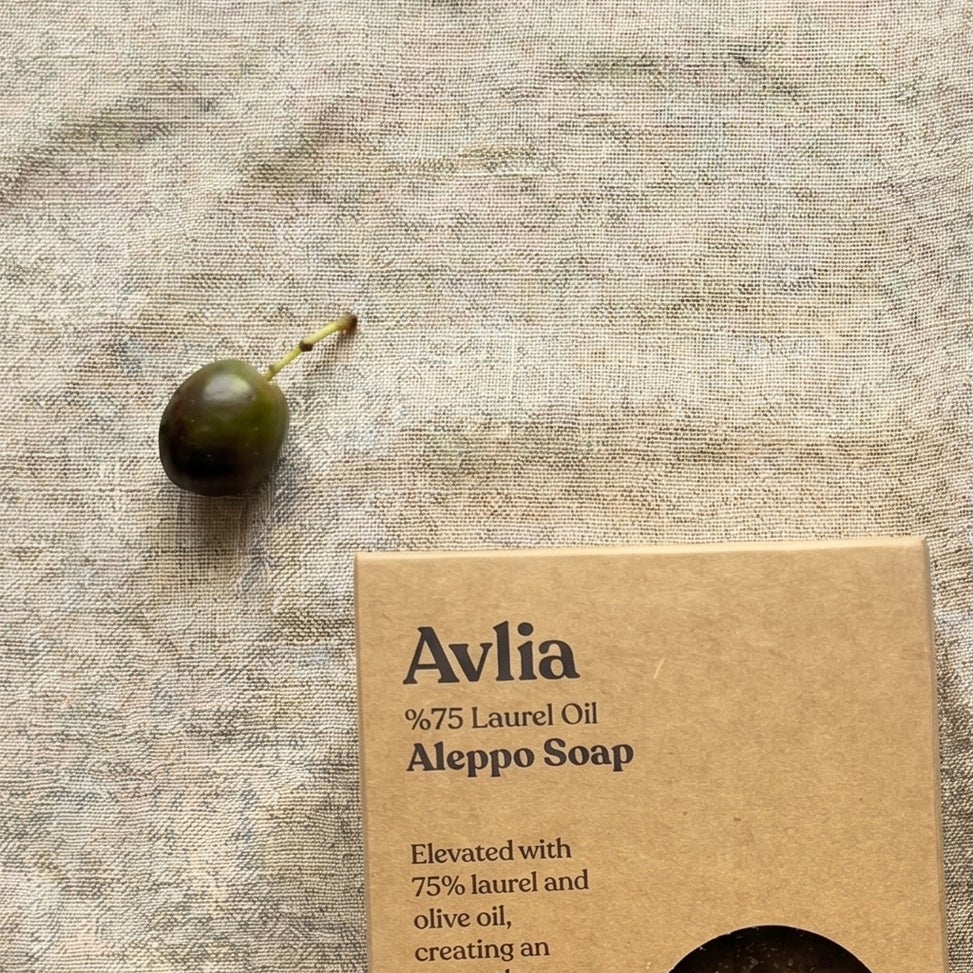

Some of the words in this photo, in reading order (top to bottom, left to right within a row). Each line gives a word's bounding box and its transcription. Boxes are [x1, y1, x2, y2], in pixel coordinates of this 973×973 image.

[402, 620, 581, 685] Avlia
[404, 707, 464, 731] %75
[471, 703, 554, 729] Laurel
[561, 701, 598, 725] Oil
[406, 741, 535, 778] Aleppo
[543, 737, 634, 773] Soap
[410, 839, 514, 865] Elevated
[517, 837, 572, 860] with
[411, 875, 466, 897] 75%
[471, 871, 538, 895] laurel
[544, 868, 589, 892] and
[413, 907, 471, 930] olive
[476, 904, 512, 930] oil,
[414, 939, 514, 962] creating
[520, 941, 550, 957] an
